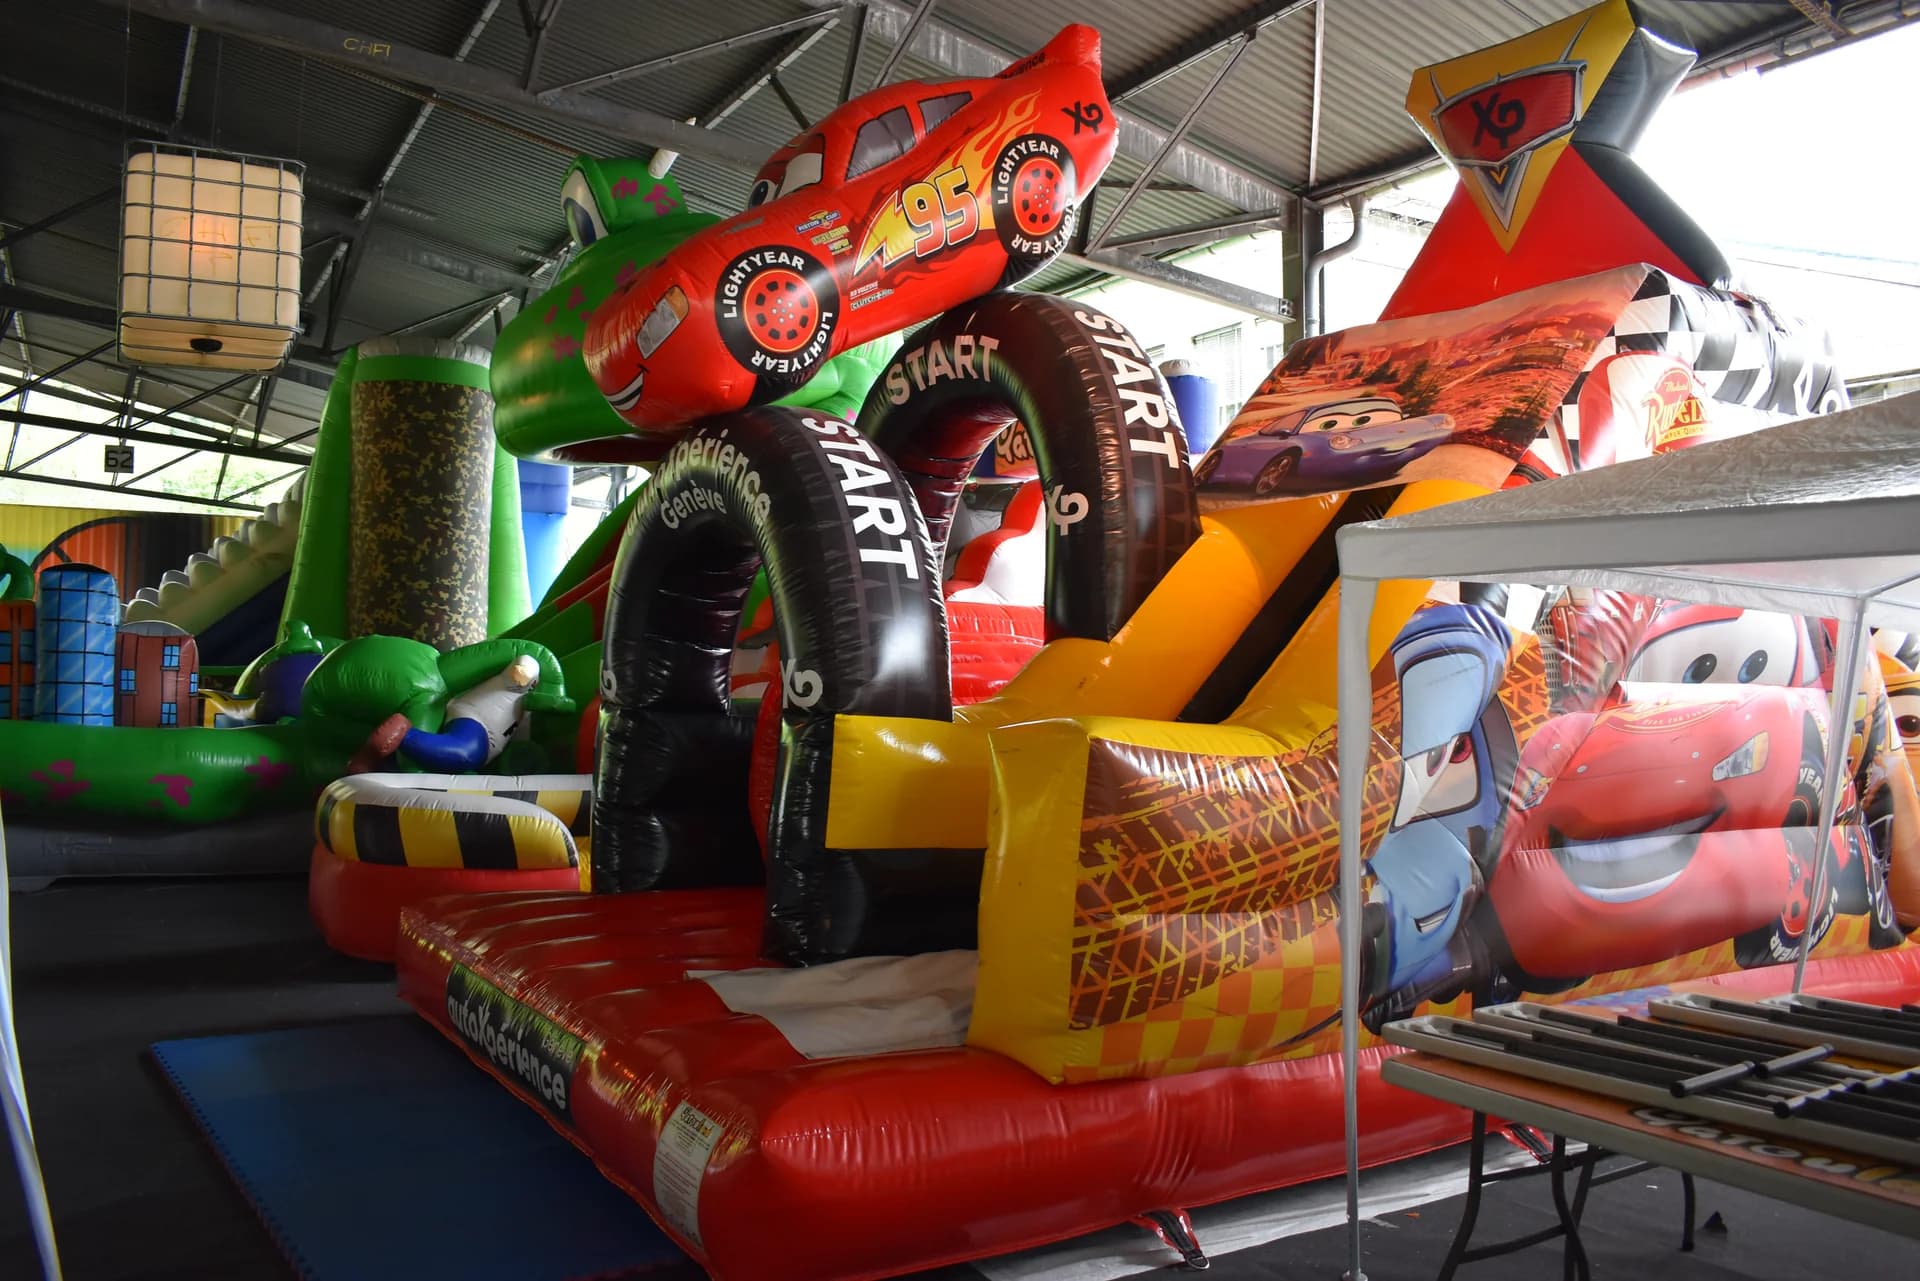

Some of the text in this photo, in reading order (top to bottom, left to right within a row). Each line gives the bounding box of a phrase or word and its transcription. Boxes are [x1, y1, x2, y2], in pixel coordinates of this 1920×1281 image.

[997, 139, 1060, 205] LIGHTYEAR
[901, 165, 980, 259] 95
[722, 251, 806, 319] LIGHTYEAR
[750, 311, 834, 374] LIGHTYEAR
[885, 334, 1001, 406] START
[1074, 310, 1181, 470] START
[661, 479, 728, 530] Genève
[801, 416, 920, 581] START
